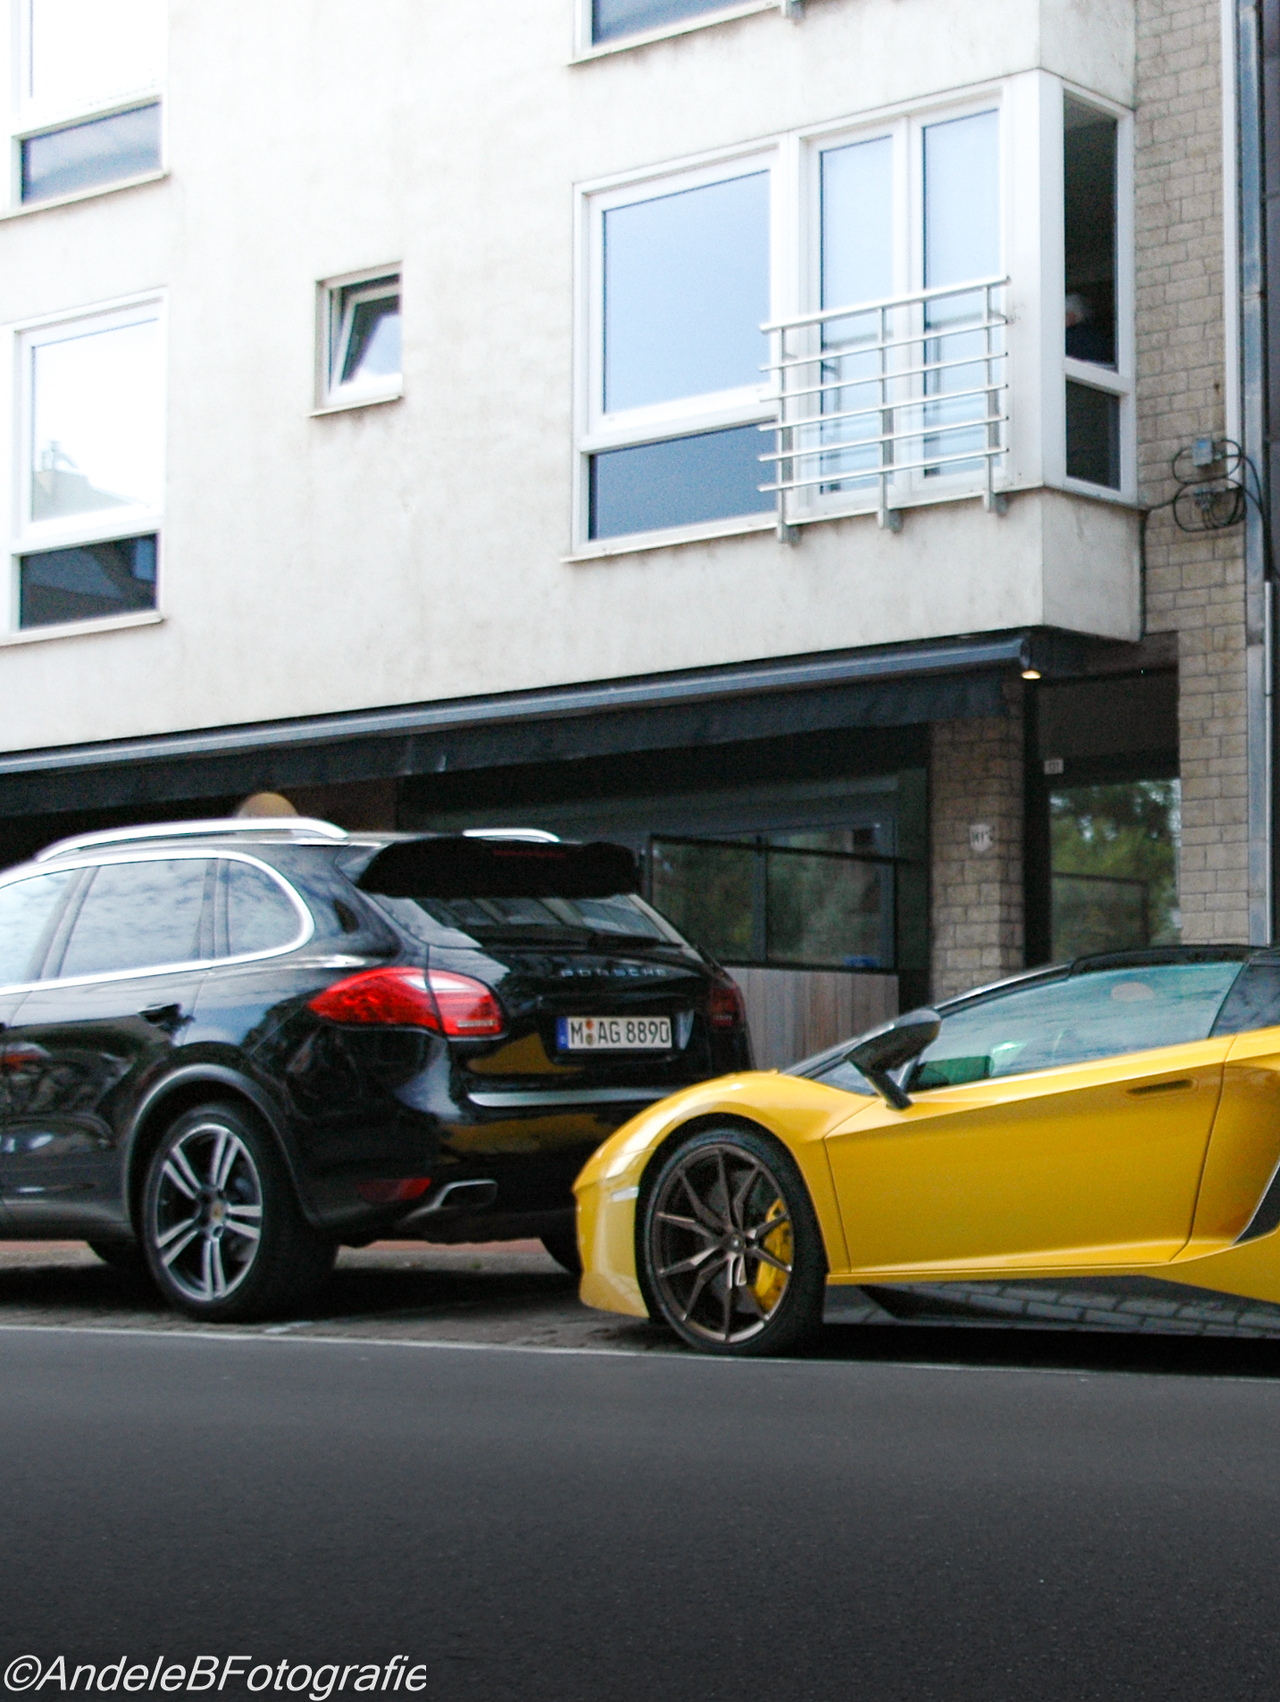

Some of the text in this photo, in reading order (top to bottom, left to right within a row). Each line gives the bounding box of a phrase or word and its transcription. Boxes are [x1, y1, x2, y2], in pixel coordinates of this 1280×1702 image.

[570, 1021, 670, 1044] M AG 8890
